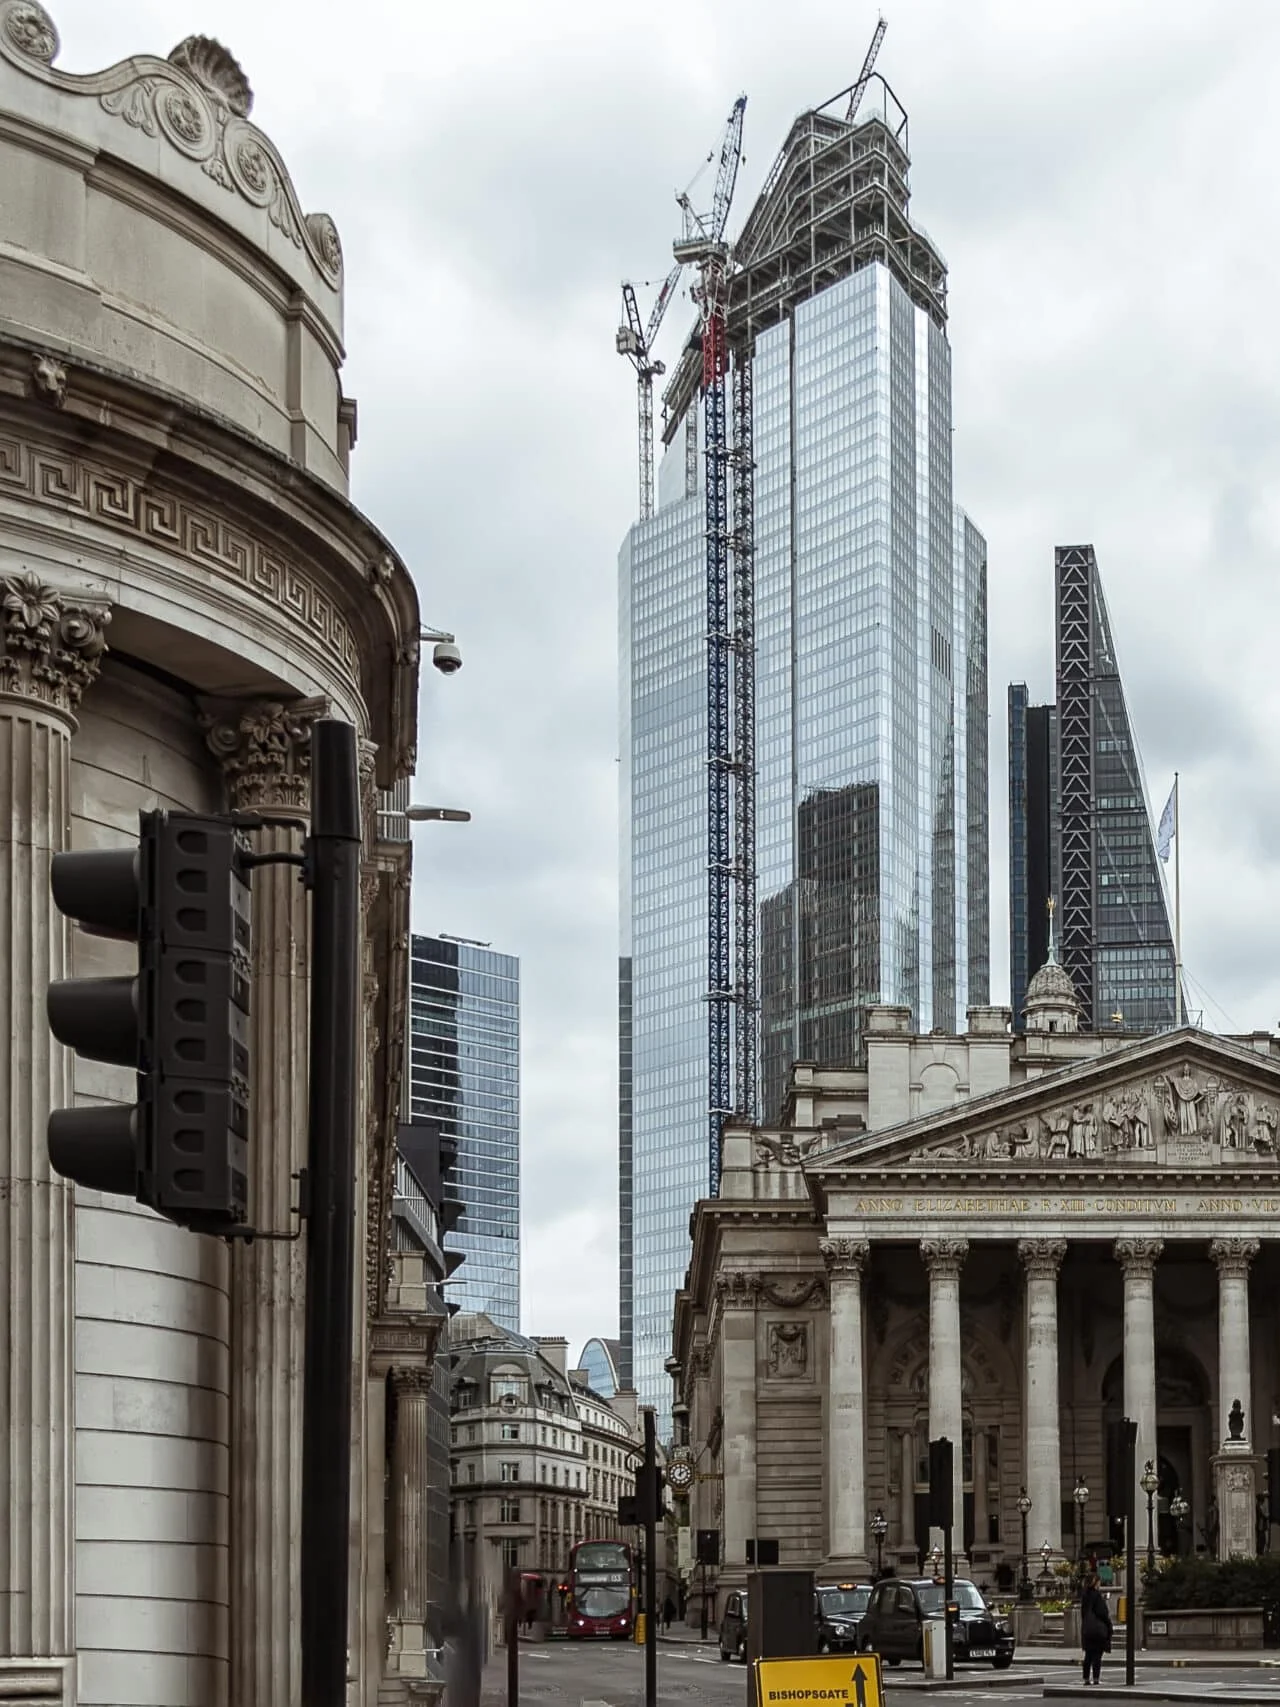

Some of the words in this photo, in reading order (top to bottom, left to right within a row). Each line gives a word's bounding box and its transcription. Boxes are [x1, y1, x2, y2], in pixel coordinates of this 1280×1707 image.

[855, 1199, 903, 1212] ANNO
[914, 1199, 1031, 1212] ELIZABETHAE
[1094, 1199, 1177, 1212] CONDITVM
[1197, 1199, 1243, 1212] ANNO
[769, 1689, 849, 1700] BISHOPSGATE
